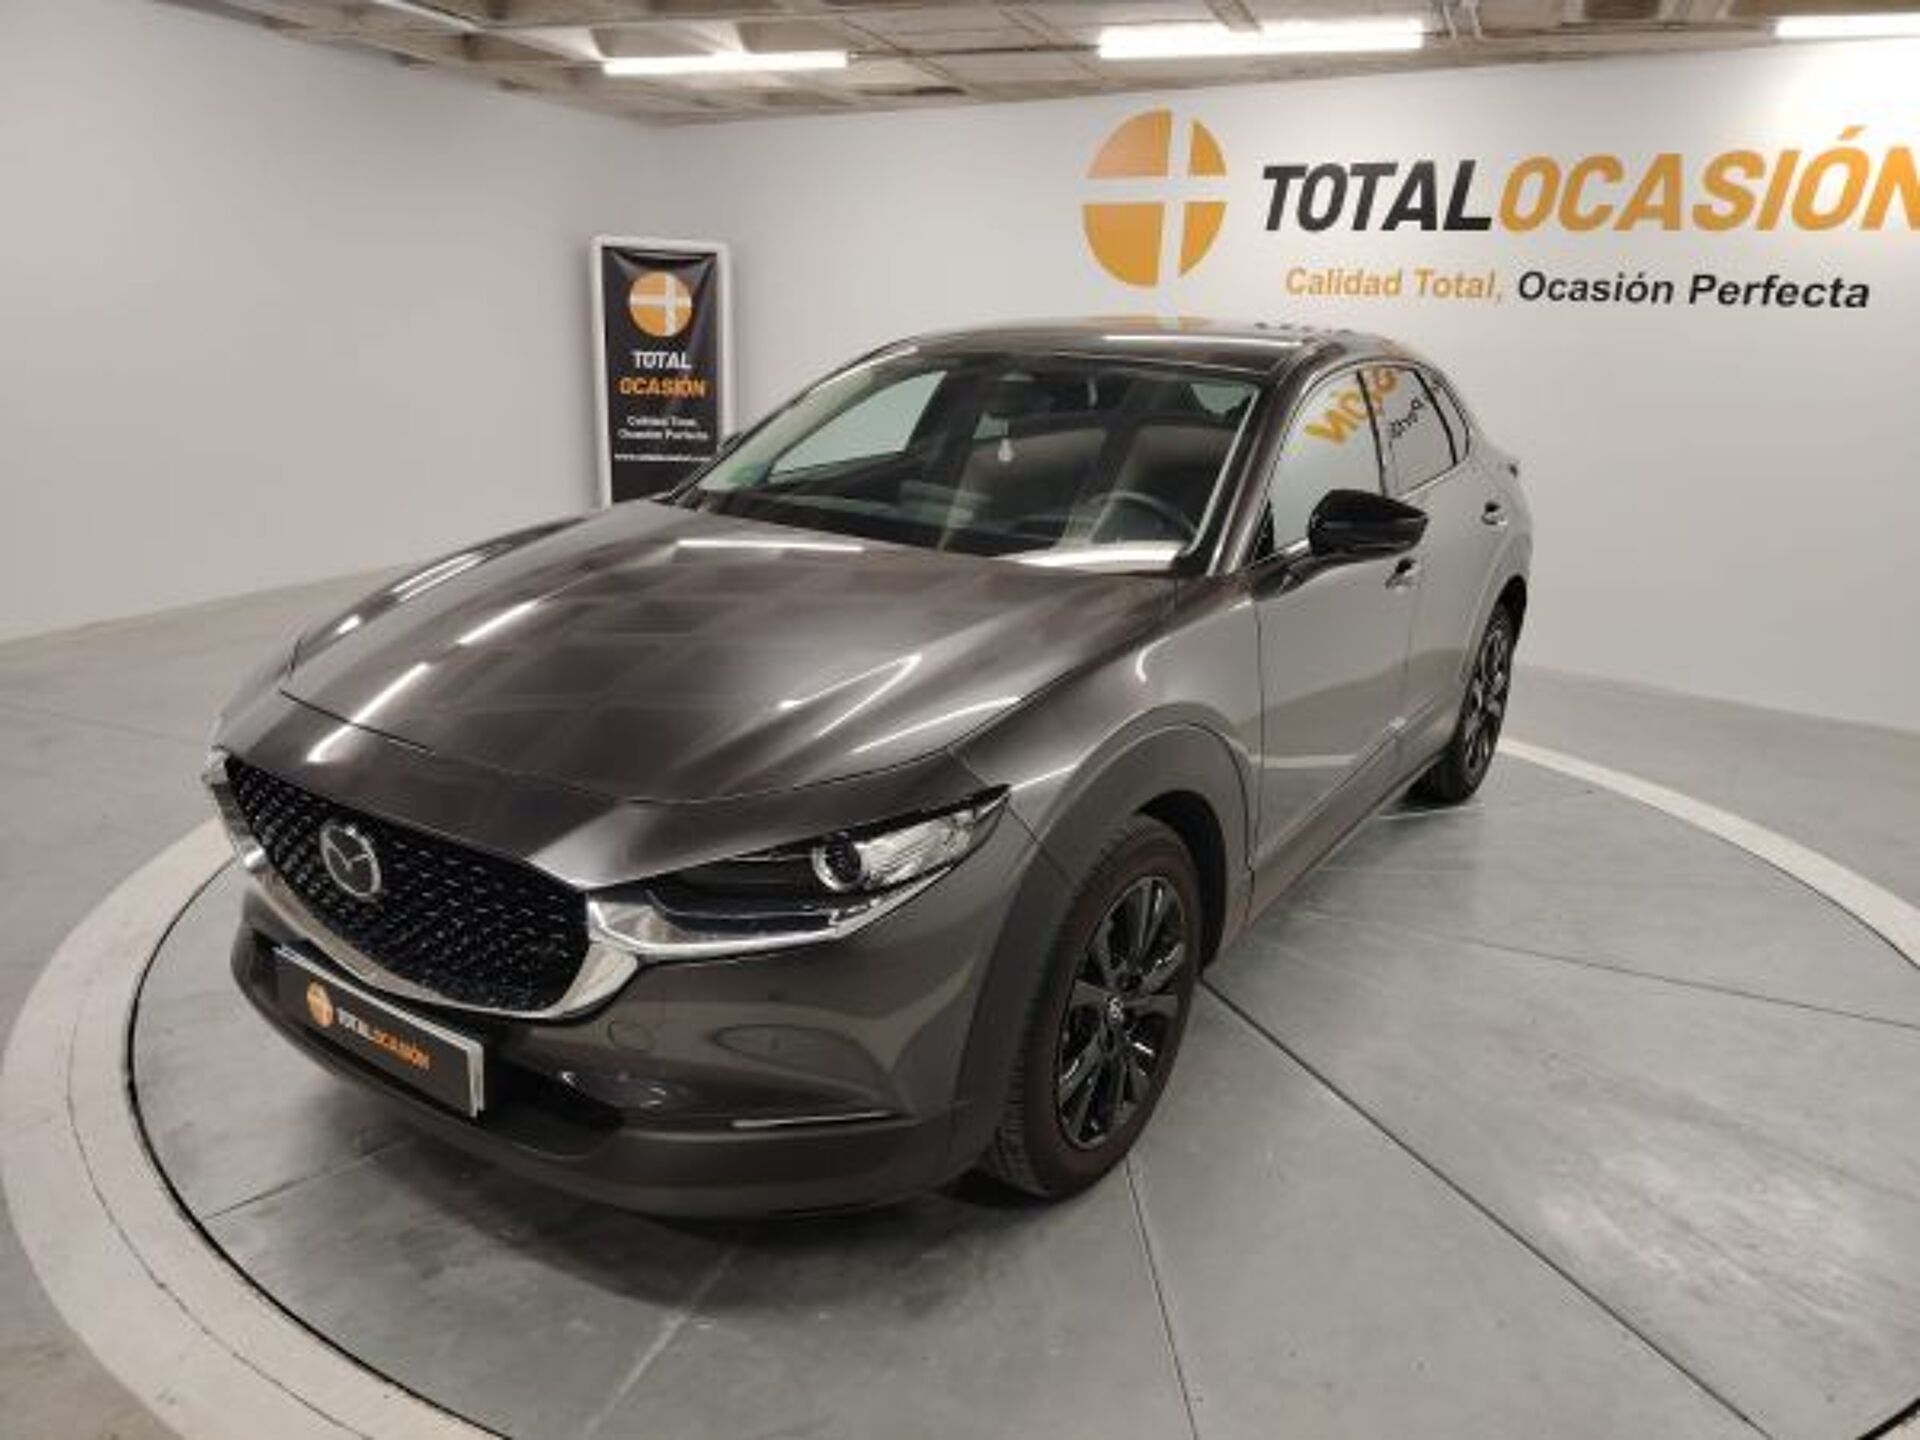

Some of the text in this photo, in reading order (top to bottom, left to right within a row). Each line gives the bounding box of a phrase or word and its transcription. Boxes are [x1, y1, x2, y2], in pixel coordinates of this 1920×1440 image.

[1262, 159, 1492, 232] TOTAL
[1285, 268, 1871, 308] Calidad Total, Ocasión Perfecta
[632, 351, 692, 369] TOTAL
[620, 375, 706, 397] OCASIÓN
